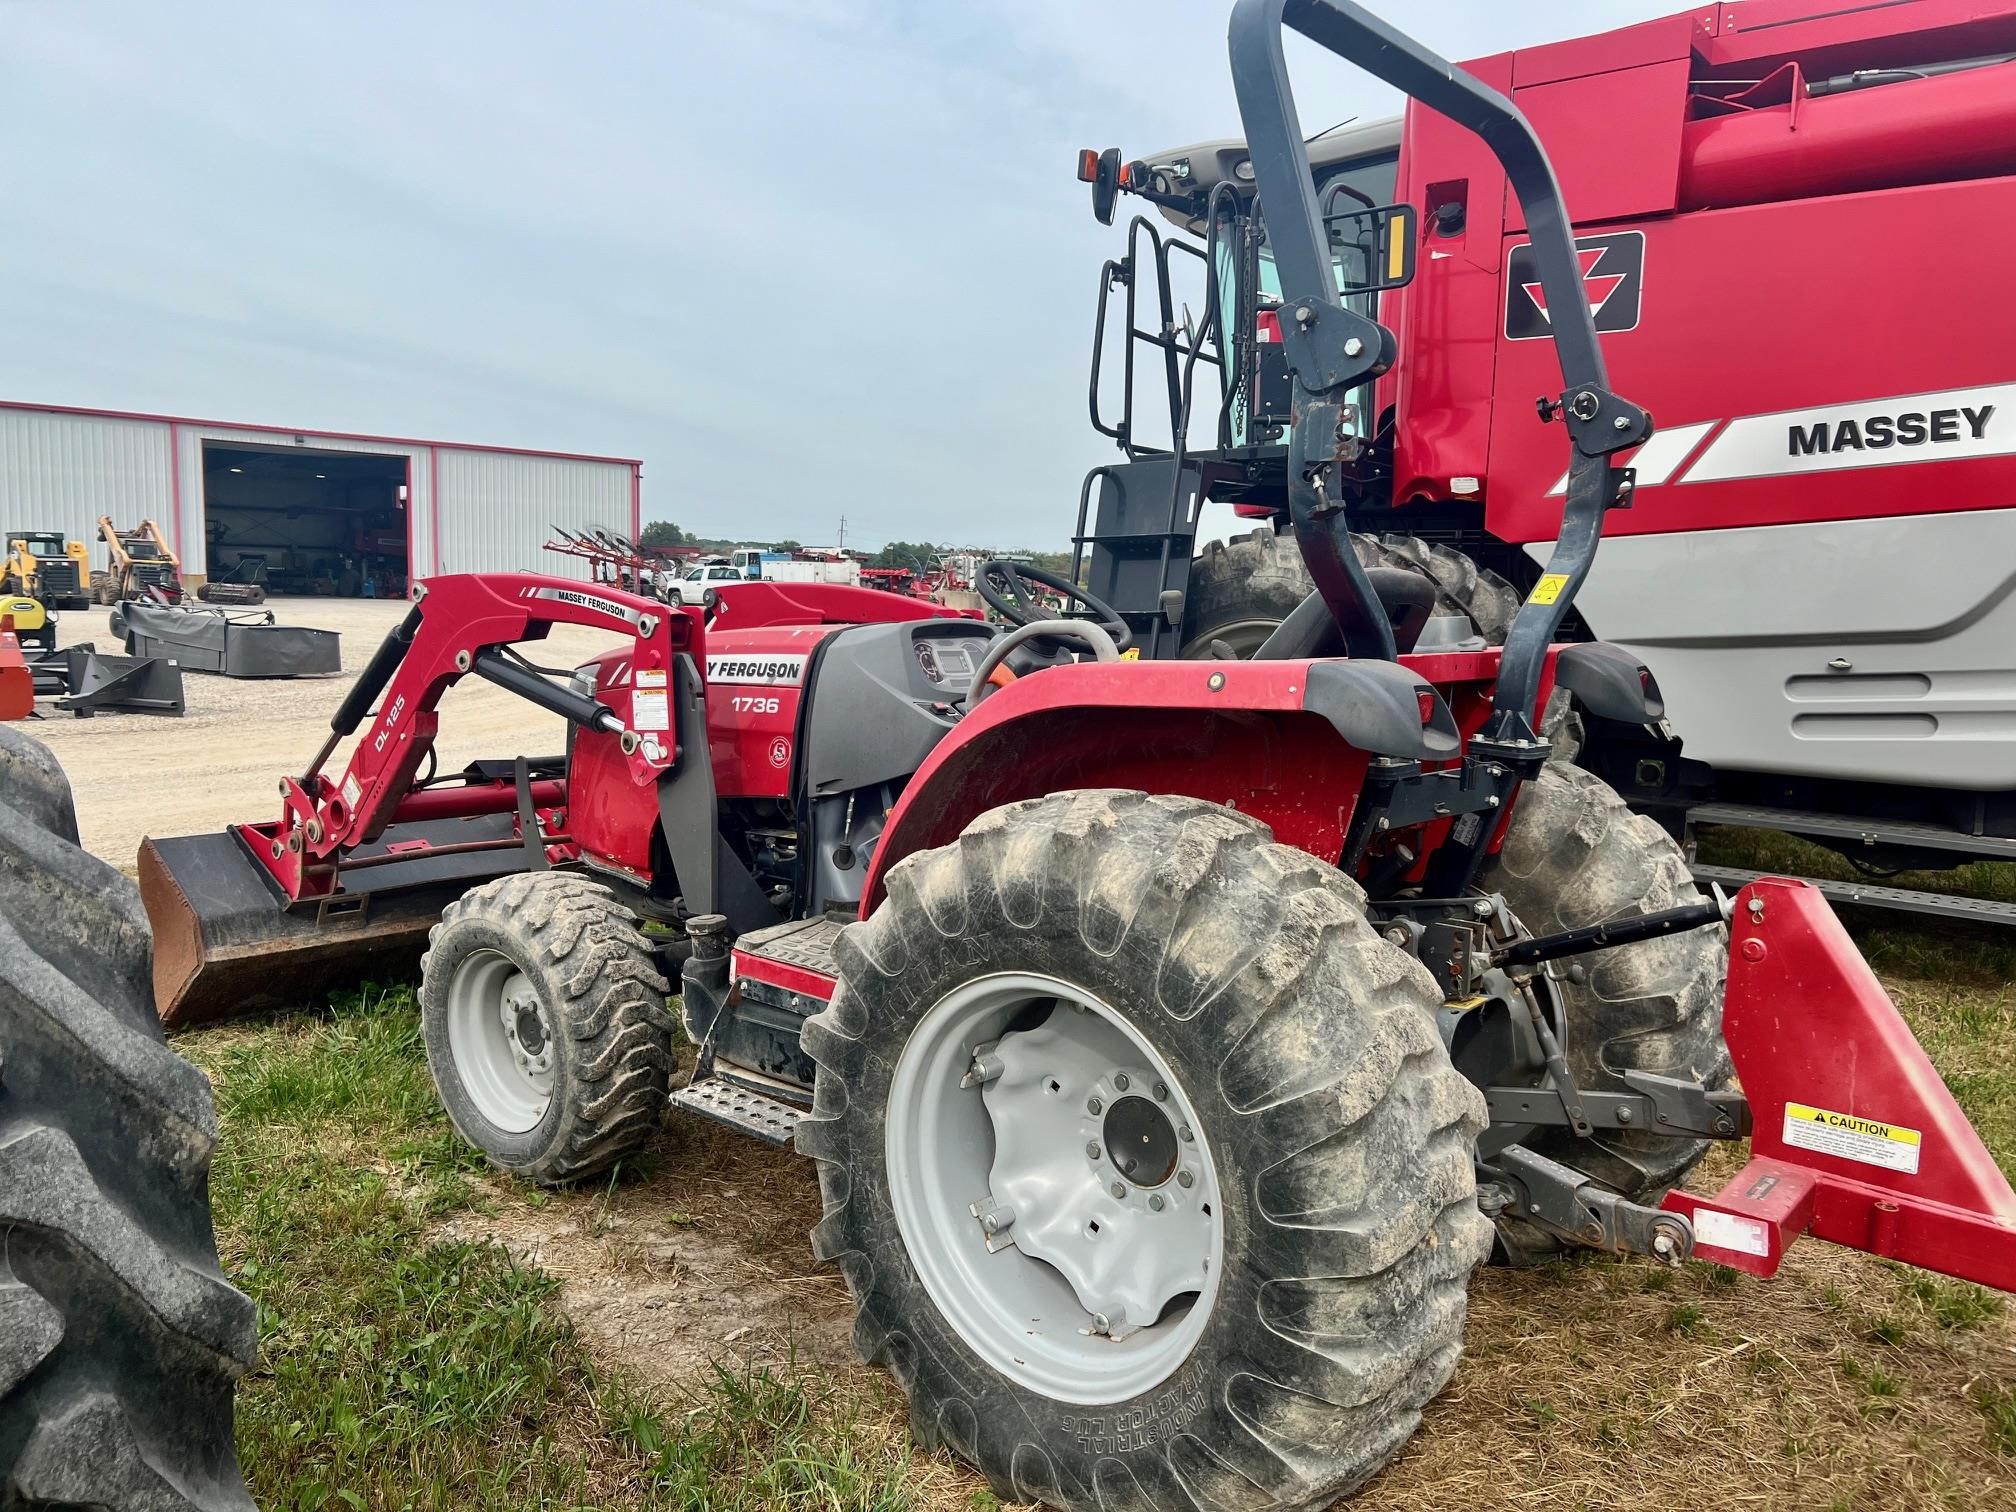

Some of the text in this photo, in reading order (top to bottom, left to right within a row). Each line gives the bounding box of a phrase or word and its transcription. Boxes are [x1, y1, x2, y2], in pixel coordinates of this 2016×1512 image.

[1789, 405, 1996, 457] MASSEY
[558, 591, 626, 618] MASSEY FERGUSON
[718, 662, 800, 678] FERGUSON
[374, 693, 405, 753] DL 125
[731, 697, 780, 714] 1736
[1829, 1115, 1889, 1137] CAUTION
[1061, 1360, 1209, 1434] TRACTOR LUG
[1077, 1391, 1206, 1454] INDUSTRIAL
